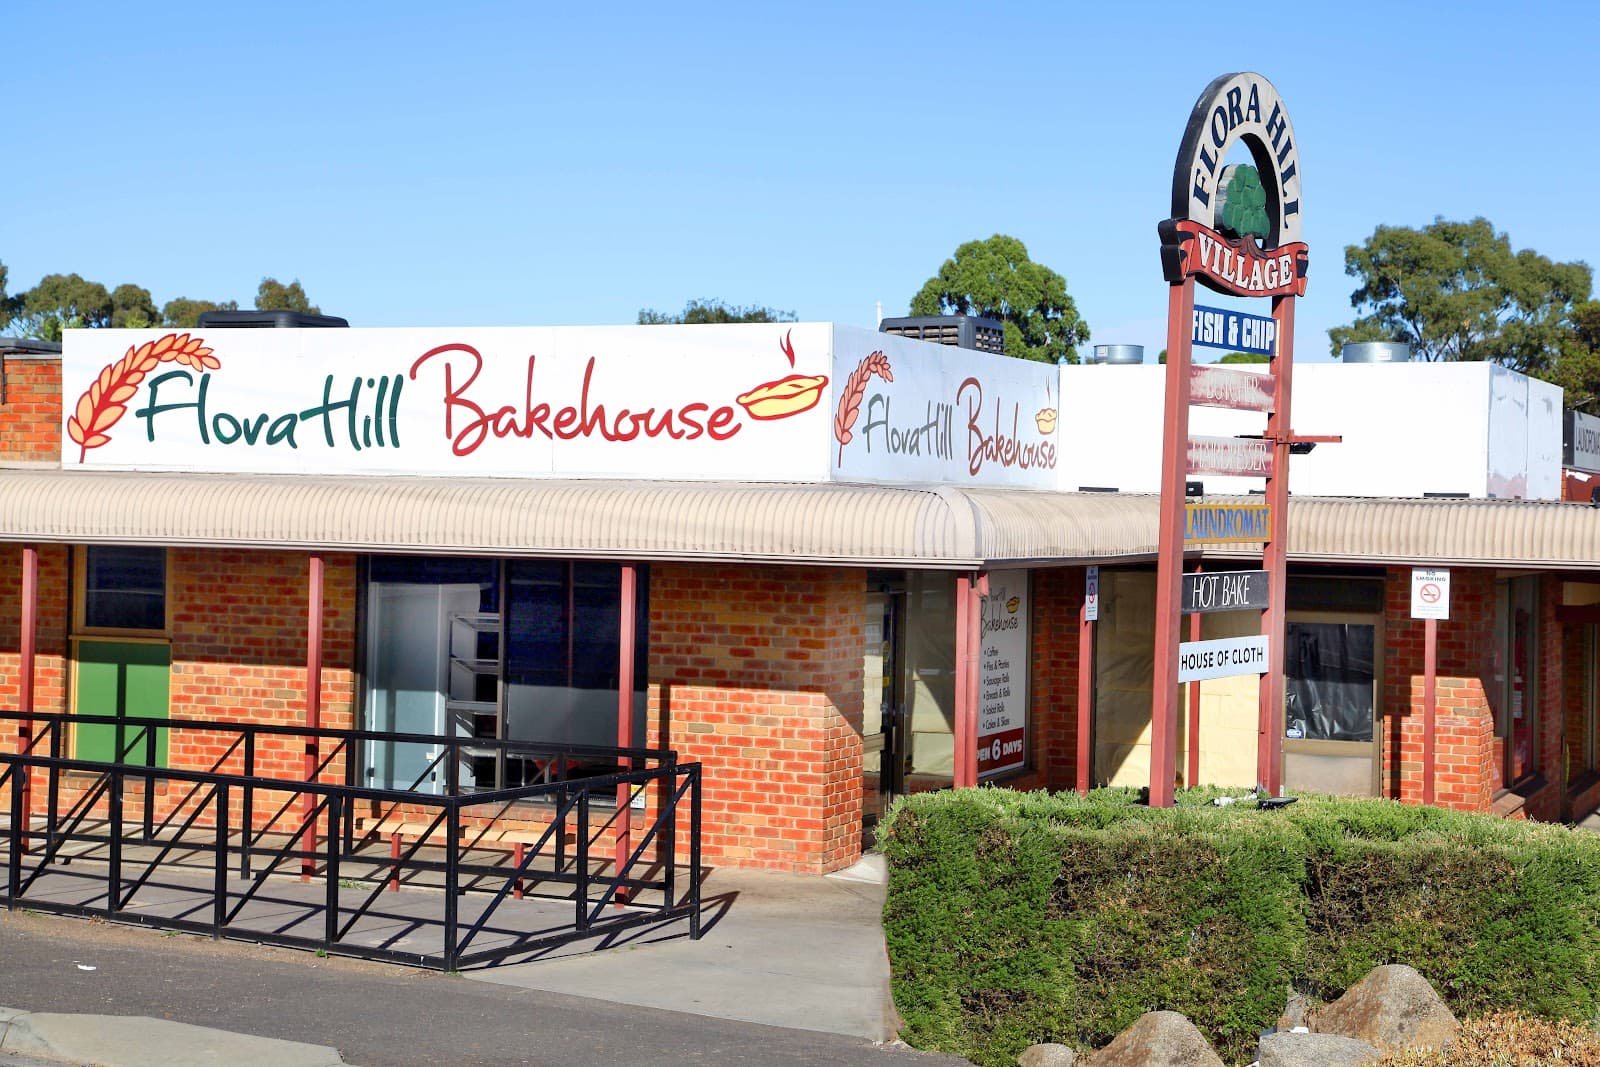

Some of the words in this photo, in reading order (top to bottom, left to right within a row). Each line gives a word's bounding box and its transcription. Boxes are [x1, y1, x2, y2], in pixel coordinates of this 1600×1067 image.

[1193, 83, 1261, 209] FLORA
[1265, 101, 1299, 229] HILL
[1198, 232, 1293, 290] VILLAGE
[1192, 309, 1224, 344] FISH
[1228, 316, 1238, 346] &
[1242, 318, 1275, 350] CHIP
[136, 369, 300, 449] Flora
[299, 374, 404, 452] Hill
[410, 343, 743, 457] Bakehouse
[862, 393, 921, 456] Flora
[920, 400, 953, 461] Hill
[956, 377, 1057, 476] Bakehouse
[1184, 508, 1269, 539] LAUNDROMAT
[1192, 576, 1219, 608] HOT
[1222, 575, 1250, 606] BAKE
[1181, 652, 1214, 671] HOUSE
[1217, 651, 1229, 667] OF
[1233, 647, 1263, 663] CLOTH
[977, 747, 990, 761] PEN
[992, 739, 1001, 760] 6
[1003, 739, 1022, 755] DAYS
